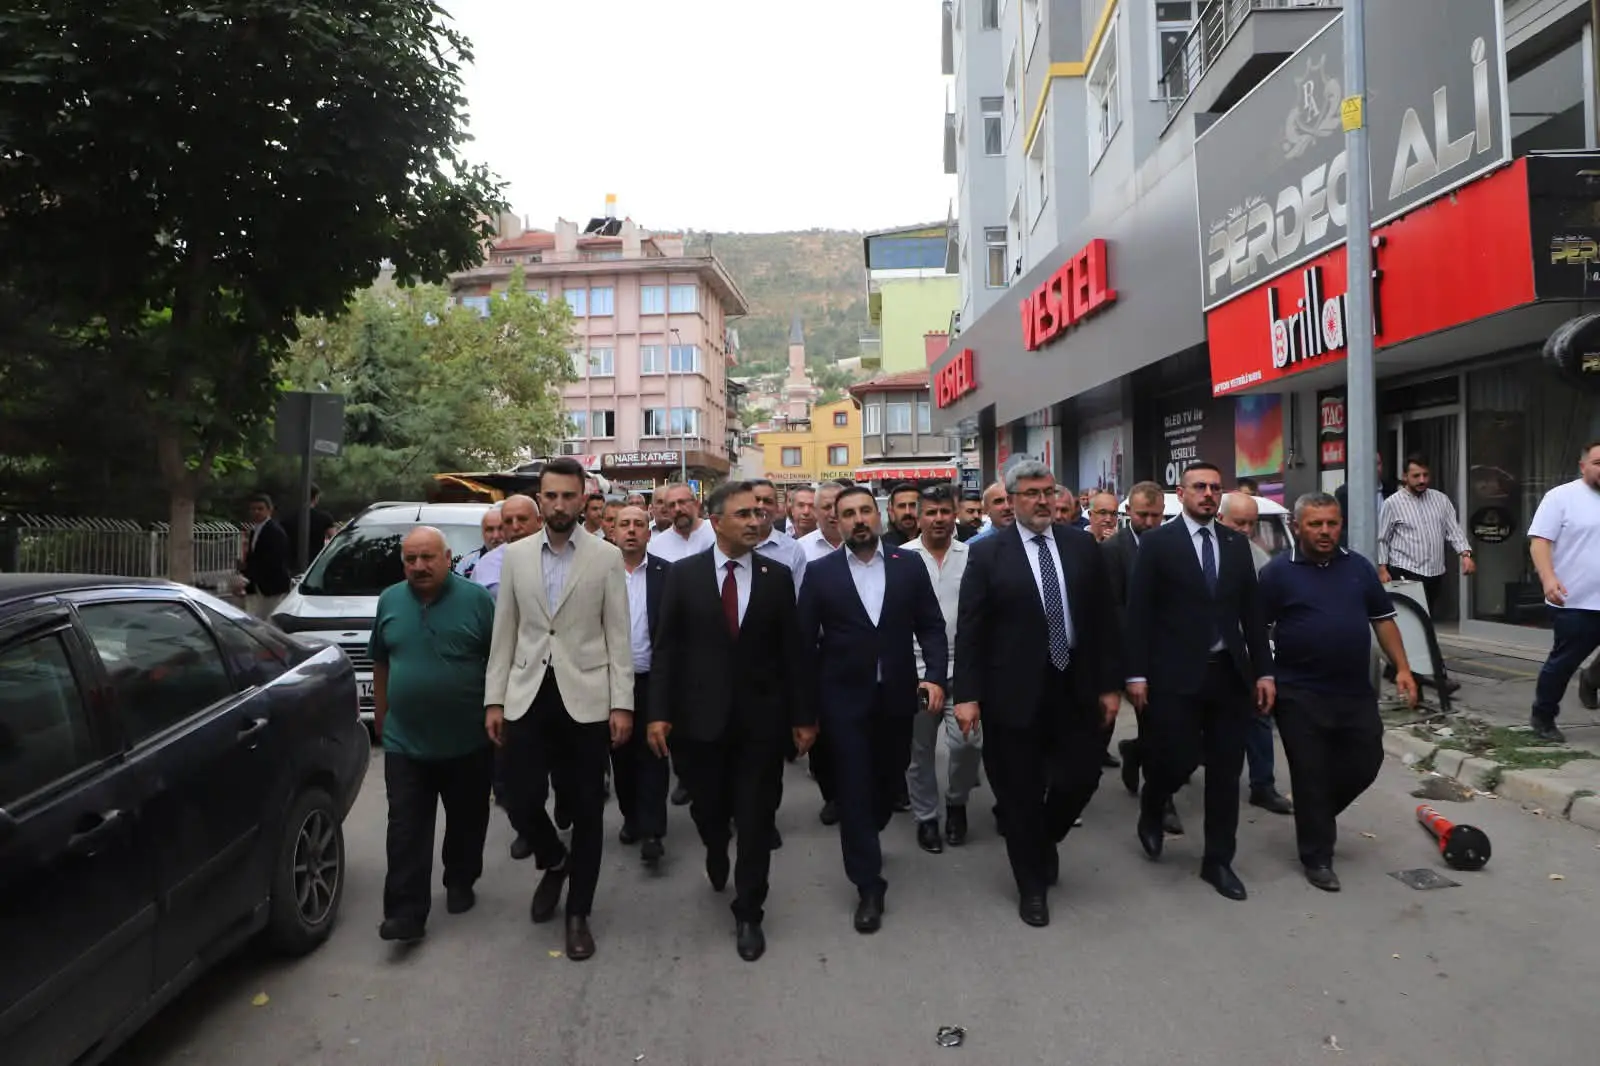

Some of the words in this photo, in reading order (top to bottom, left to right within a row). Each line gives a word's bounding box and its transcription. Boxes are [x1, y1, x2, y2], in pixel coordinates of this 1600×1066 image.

[1389, 37, 1491, 200] ALİ
[1020, 238, 1117, 351] VESTEL
[934, 348, 977, 408] VESTEL
[614, 453, 640, 464] NARE
[640, 451, 678, 461] KATMER
